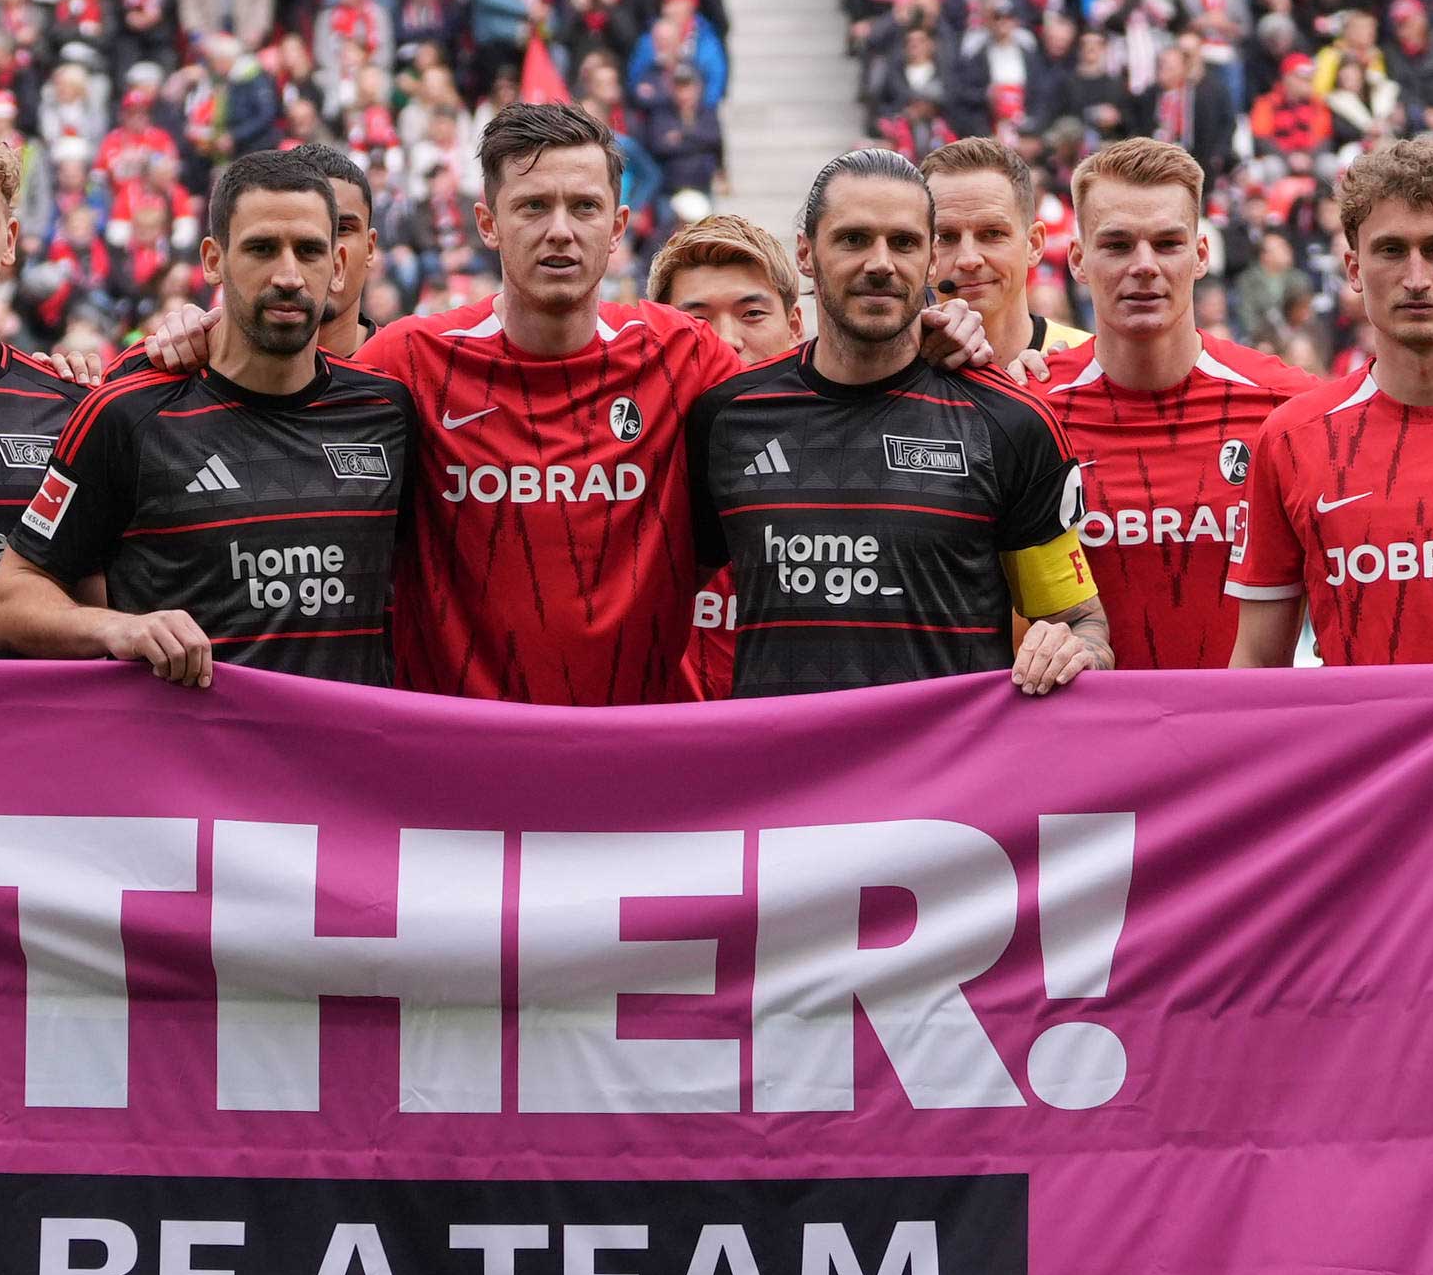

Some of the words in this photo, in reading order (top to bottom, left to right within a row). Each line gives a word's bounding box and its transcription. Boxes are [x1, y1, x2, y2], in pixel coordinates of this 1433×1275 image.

[442, 462, 646, 504] JOBRAD
[765, 524, 879, 564] home
[1077, 505, 1240, 549] OBRA
[229, 540, 344, 580] home
[777, 558, 817, 595] to
[248, 578, 291, 609] to
